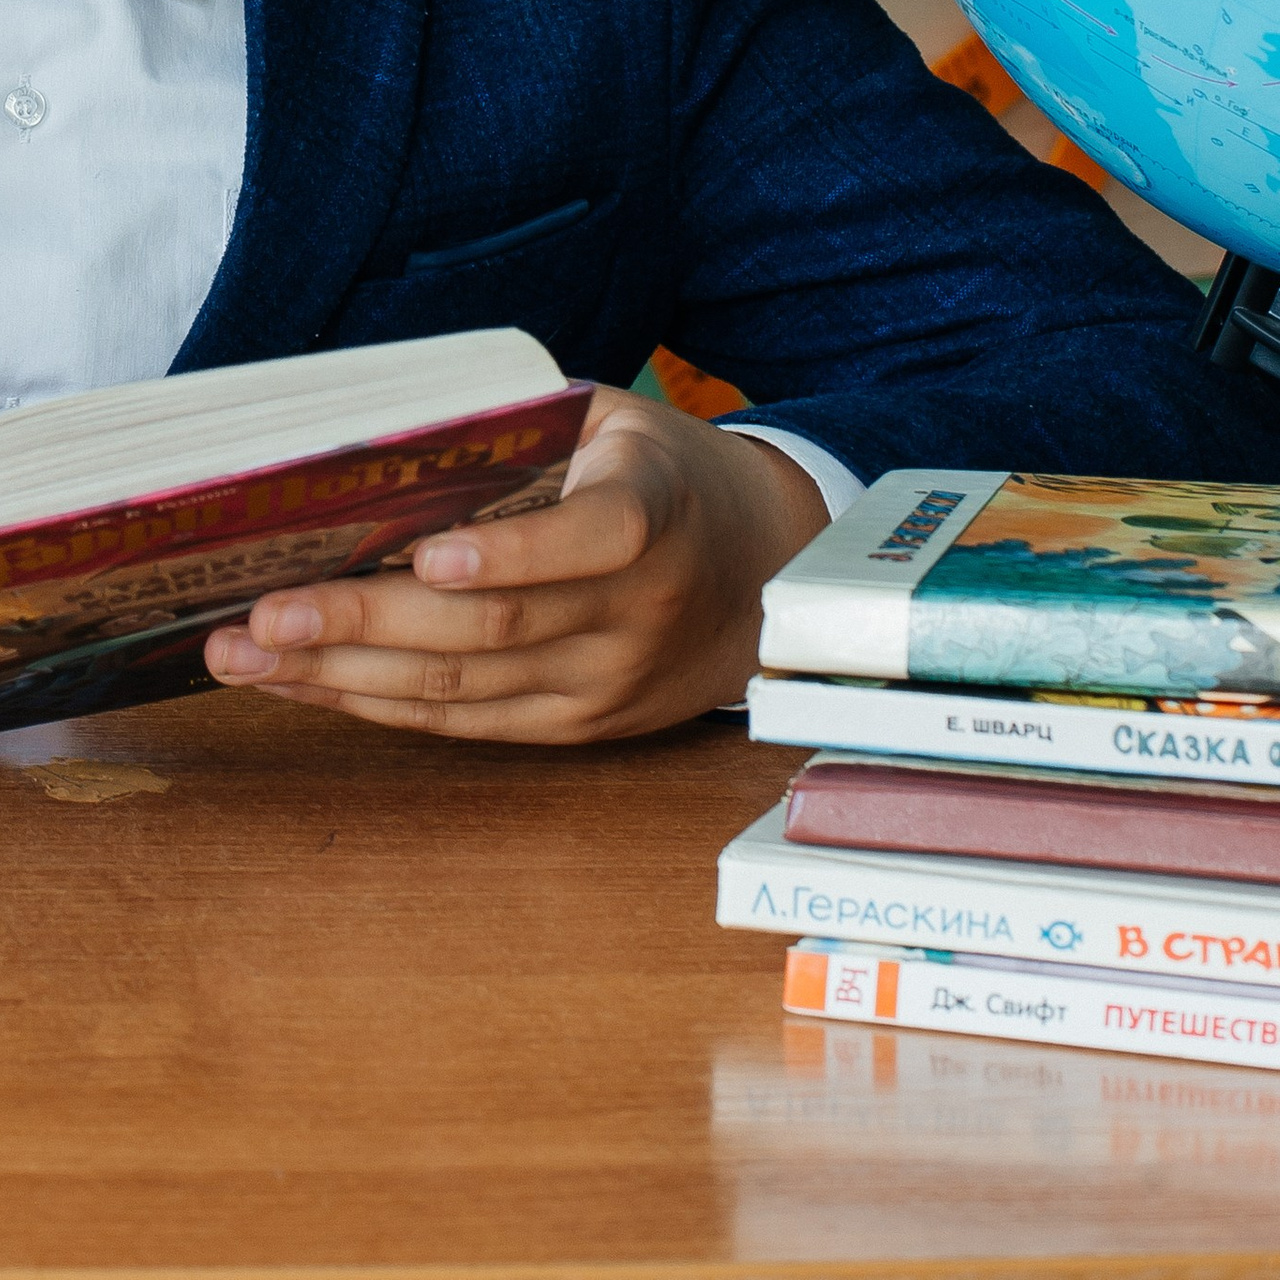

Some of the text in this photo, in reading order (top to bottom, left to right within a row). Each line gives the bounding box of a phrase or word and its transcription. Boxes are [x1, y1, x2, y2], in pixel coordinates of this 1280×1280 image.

[973, 719, 1053, 742] ШВАРЦ
[1114, 724, 1250, 765] СКАЗКА
[1118, 925, 1148, 958] В
[1163, 932, 1280, 971] СТРА
[986, 993, 1068, 1025] Свифт
[1105, 1004, 1278, 1046] ПУТЕШЕСТВ
